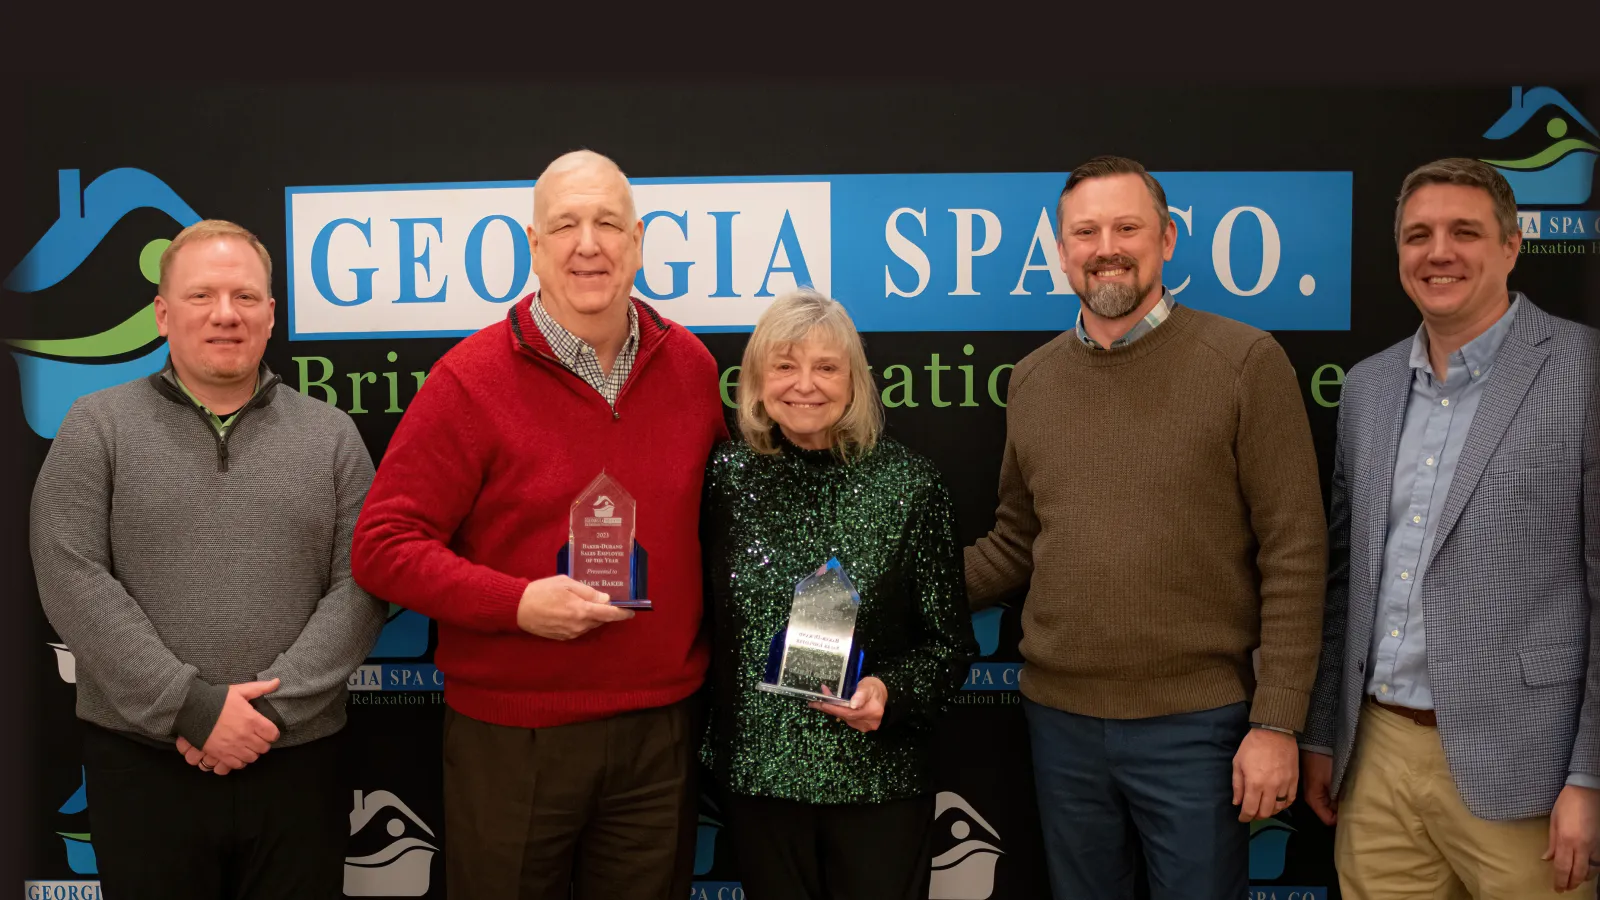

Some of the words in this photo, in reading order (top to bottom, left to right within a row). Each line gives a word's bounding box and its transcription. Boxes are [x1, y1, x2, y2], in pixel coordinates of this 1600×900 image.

[1549, 216, 1585, 233] SPA
[1519, 241, 1585, 254] elaxation
[310, 208, 815, 307] GEOGIA
[885, 206, 1076, 299] SPA
[390, 669, 424, 686] SPA
[964, 668, 994, 685] PA
[352, 693, 425, 705] Relaxation
[28, 885, 101, 900] GEORGI
